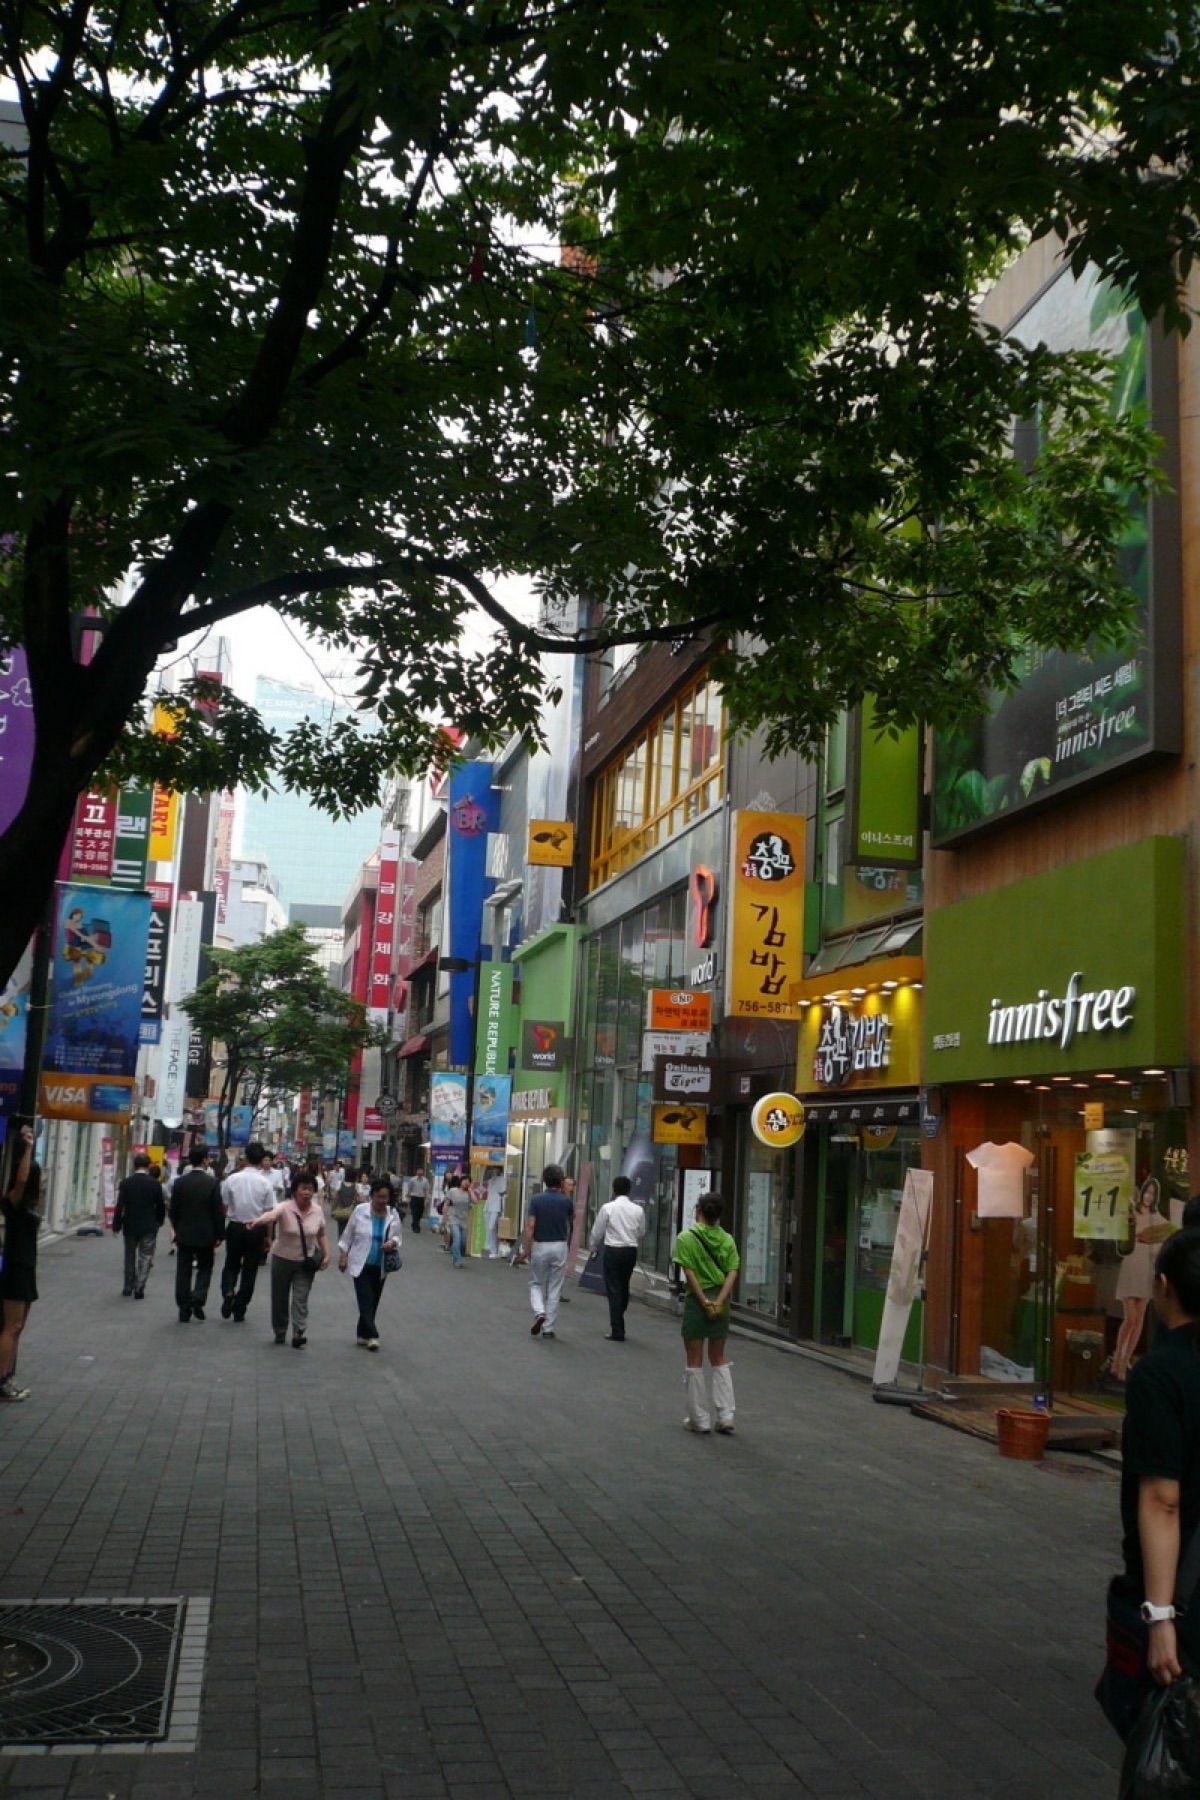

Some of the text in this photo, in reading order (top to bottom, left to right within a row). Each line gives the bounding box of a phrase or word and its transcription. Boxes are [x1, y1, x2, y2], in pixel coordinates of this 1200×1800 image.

[1055, 704, 1137, 763] innisfree
[111, 790, 147, 883] 랜드
[860, 830, 913, 848] 이니스프리
[373, 881, 395, 986] 금강제화
[485, 970, 502, 1077] NATURE REPUBLIC
[987, 971, 1136, 1050] innisfree
[532, 1052, 556, 1061] world
[44, 1085, 87, 1104] VISA
[1079, 1185, 1120, 1218] 1+1
